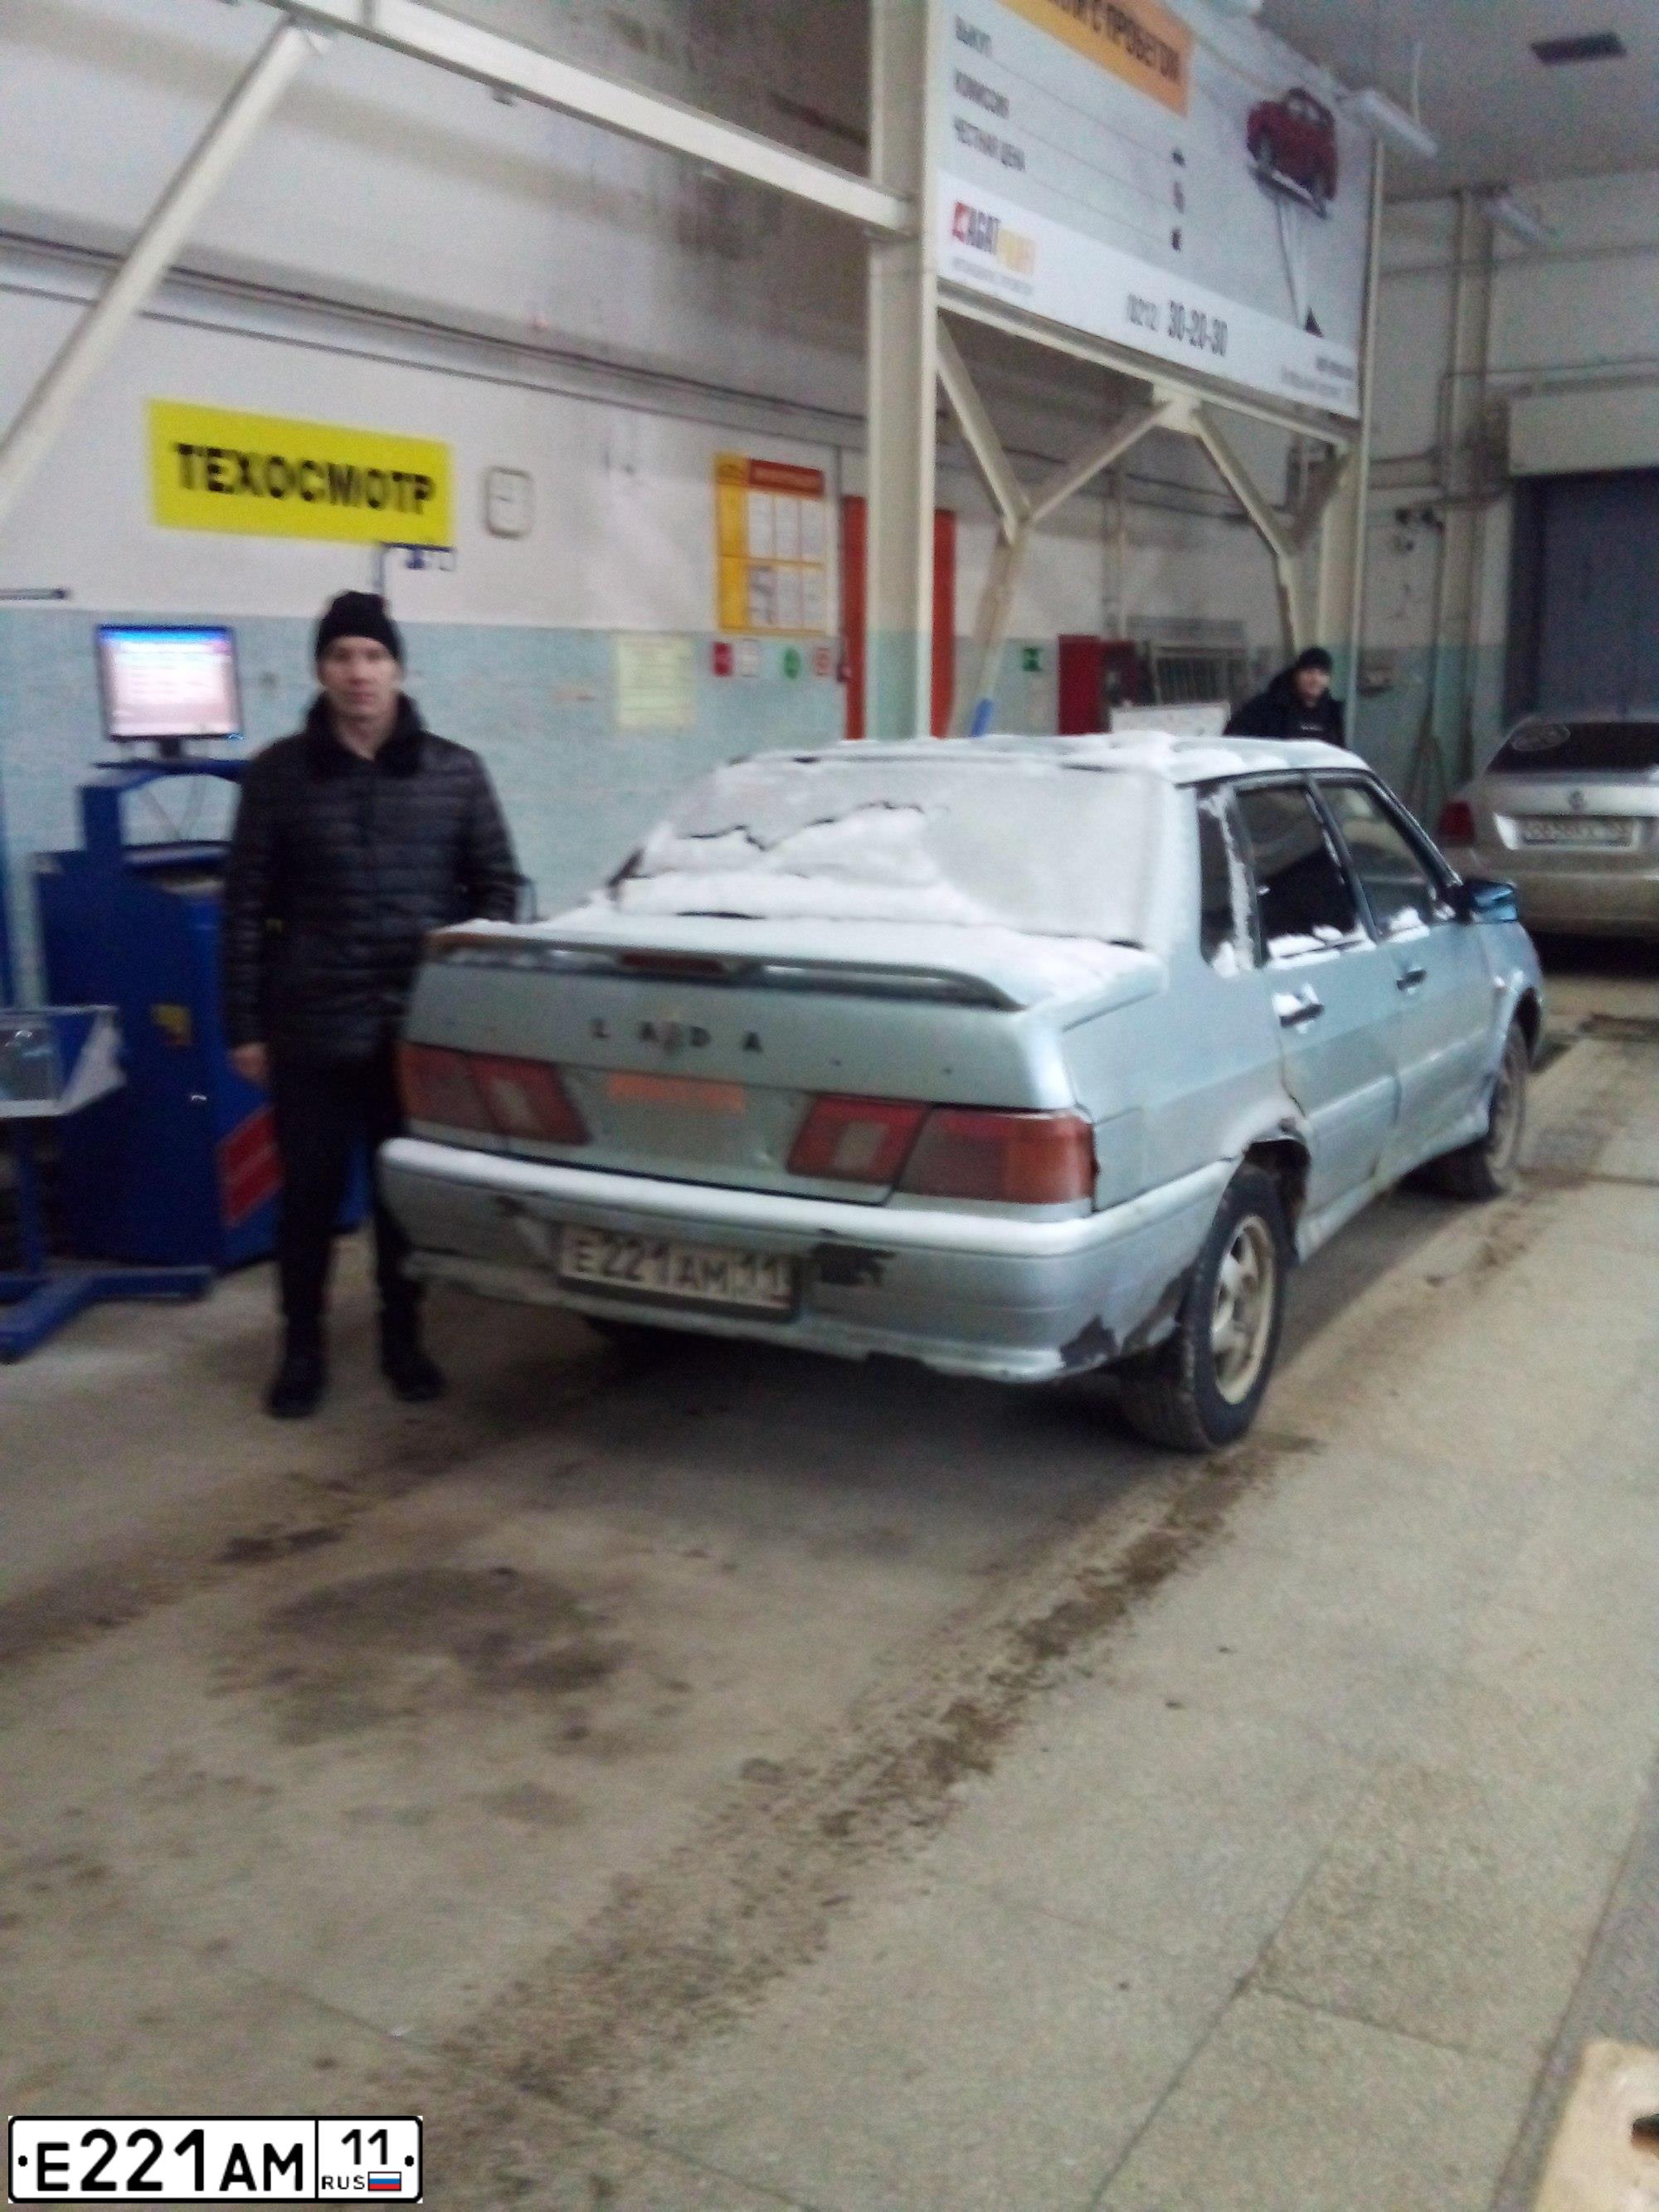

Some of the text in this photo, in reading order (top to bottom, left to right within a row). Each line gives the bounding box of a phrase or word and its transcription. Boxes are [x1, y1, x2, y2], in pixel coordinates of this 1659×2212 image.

[1167, 299, 1228, 358] 30-20-30
[173, 441, 437, 515] ТЕХОСМОТР
[591, 1017, 763, 1054] LADA
